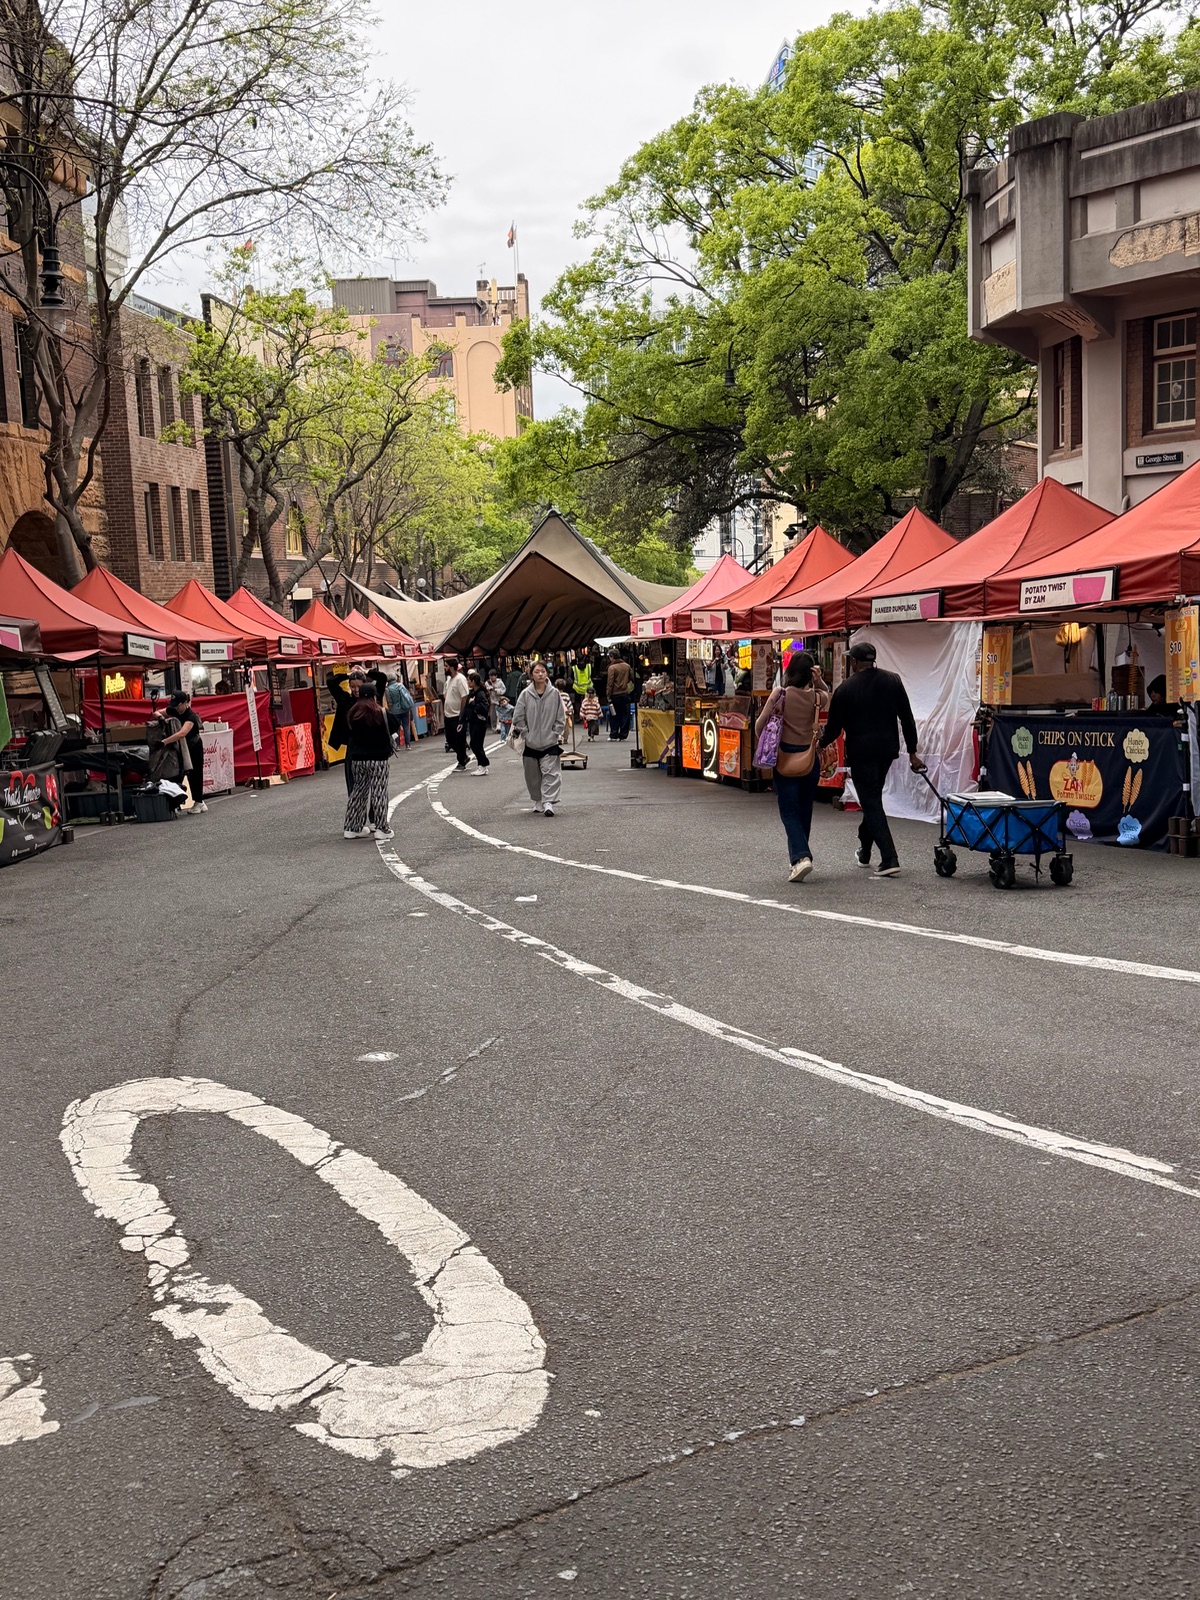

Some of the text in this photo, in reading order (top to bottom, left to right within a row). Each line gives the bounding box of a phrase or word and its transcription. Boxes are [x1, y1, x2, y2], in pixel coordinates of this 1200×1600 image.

[1025, 582, 1067, 594] POTATO TWIST
[1024, 595, 1046, 605] BY ZAM
[892, 603, 917, 612] DUMPLINGS
[1169, 641, 1182, 654] $10
[986, 653, 998, 664] $10
[1038, 730, 1115, 747] CHIPS ON STICK
[1127, 737, 1145, 747] Honey
[1126, 745, 1147, 755] Chicken
[1063, 777, 1084, 792] ZAM
[4, 785, 21, 807] That's
[1057, 790, 1096, 801] Potato Twister
